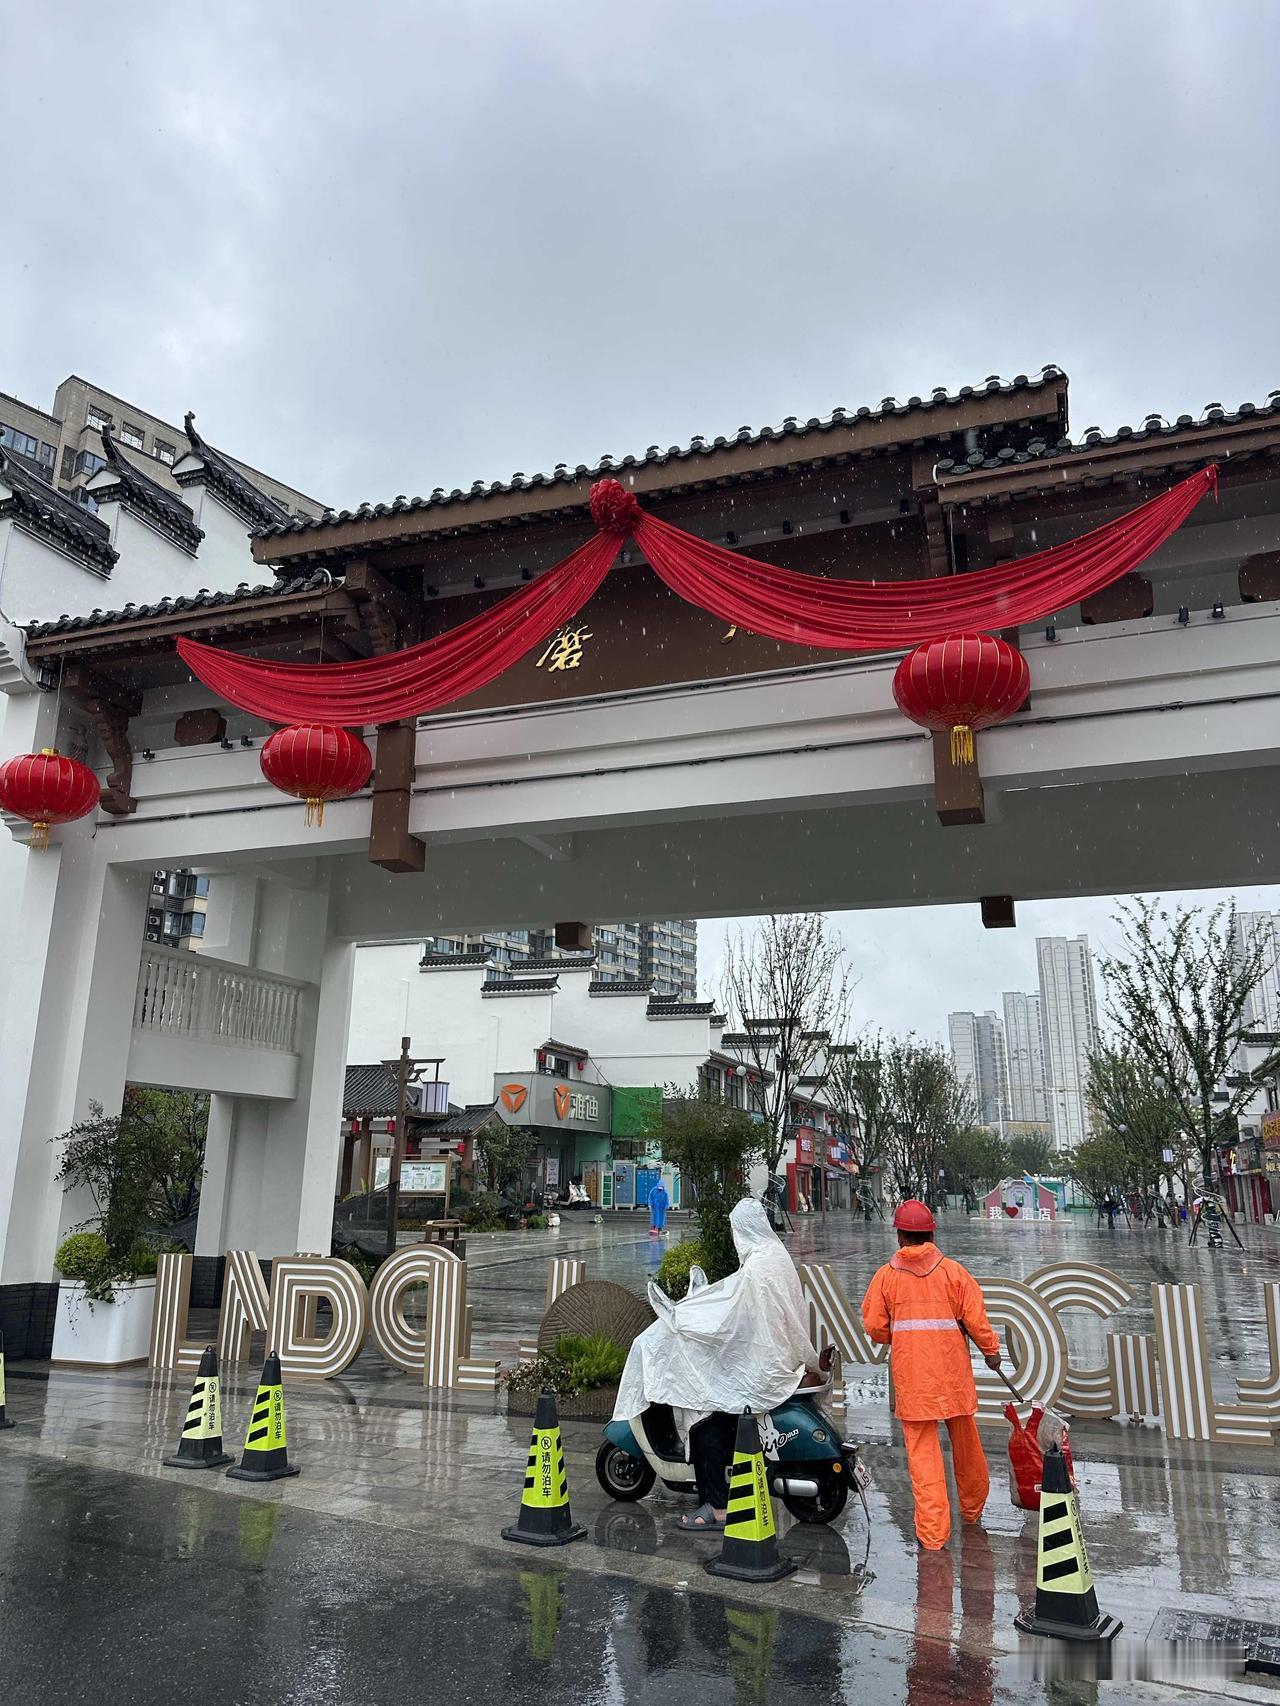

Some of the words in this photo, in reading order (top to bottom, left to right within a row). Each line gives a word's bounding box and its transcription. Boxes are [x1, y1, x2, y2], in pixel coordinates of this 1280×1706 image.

[569, 1093, 600, 1123] 雅迪
[208, 1393, 217, 1431] 请勿泊车
[274, 1402, 283, 1440] 请勿泊车
[541, 1451, 552, 1498] 请勿泊车
